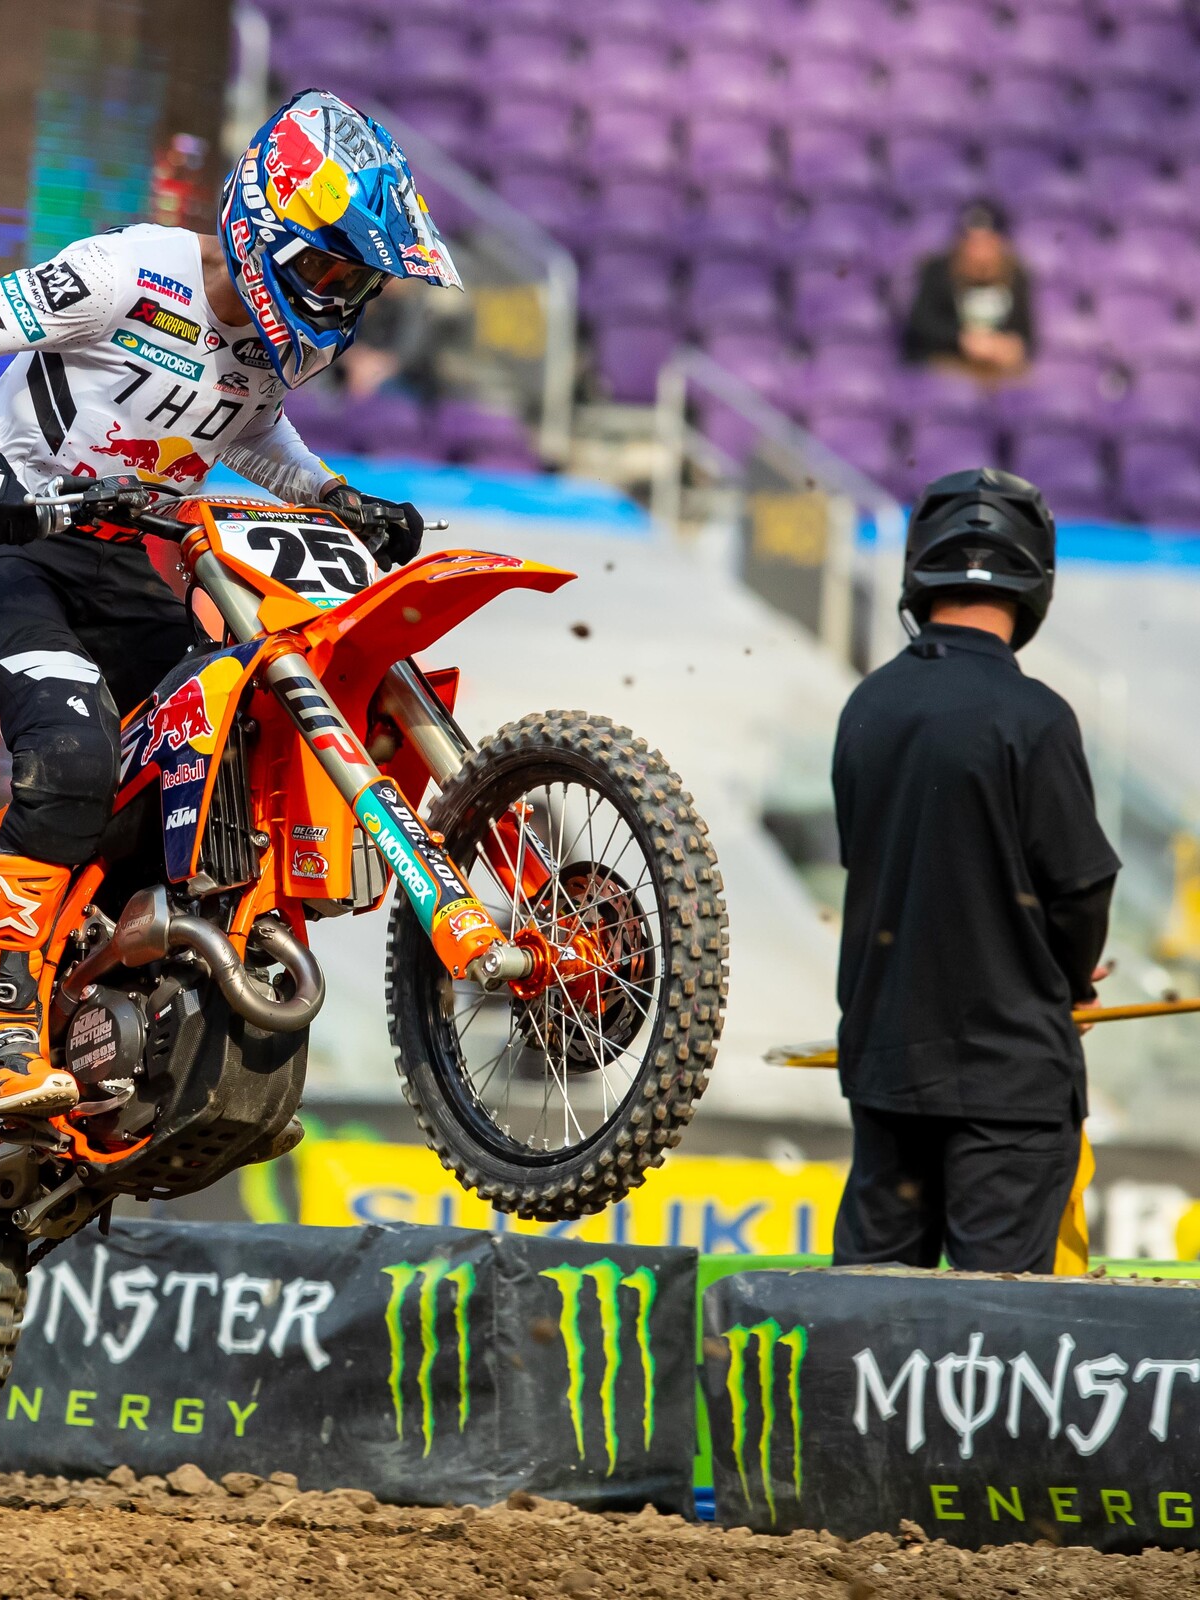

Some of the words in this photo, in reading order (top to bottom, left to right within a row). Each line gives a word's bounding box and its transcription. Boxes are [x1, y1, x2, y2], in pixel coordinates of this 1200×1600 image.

[242, 143, 287, 242] 100%
[292, 224, 317, 243] AIROH
[368, 229, 393, 267] AIROH
[136, 278, 191, 306] UNLIMITED
[138, 267, 193, 298] PARTS
[230, 216, 264, 287] Red
[248, 284, 291, 347] Bull
[2, 276, 40, 336] MOTOREX
[139, 343, 199, 378] MOTOREX
[236, 341, 271, 360] Airo
[247, 527, 372, 594] 25
[163, 764, 182, 790] Red
[181, 758, 205, 784] Bull
[165, 806, 197, 831] KTM
[376, 827, 432, 906] MOTOREX
[70, 1019, 113, 1051] FACTORY
[72, 1007, 106, 1037] KTM
[7, 1384, 259, 1438] NERGY
